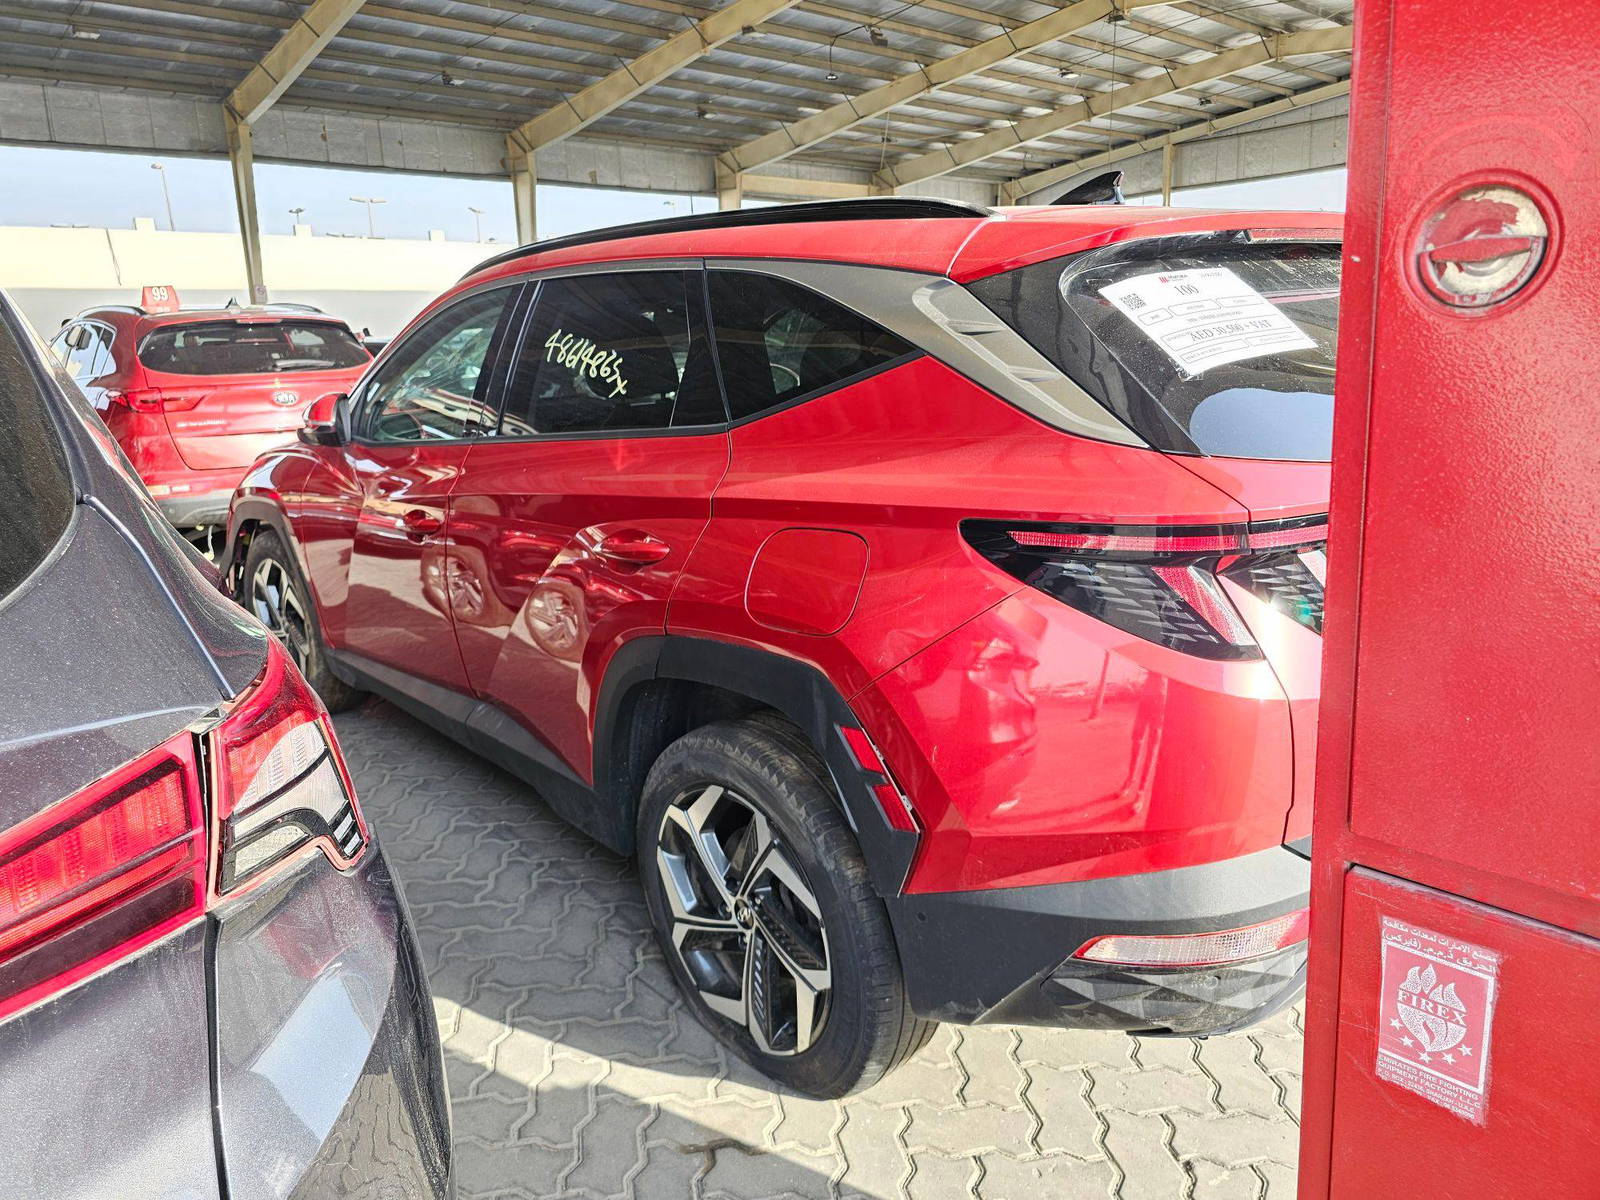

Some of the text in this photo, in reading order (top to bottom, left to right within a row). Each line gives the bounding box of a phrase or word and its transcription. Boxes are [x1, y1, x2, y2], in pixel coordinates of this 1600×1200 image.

[152, 286, 169, 301] 99
[1190, 328, 1214, 342] AED
[1249, 319, 1272, 329] VAT
[1397, 988, 1467, 1027] FIREX
[1377, 1060, 1419, 1082] QUIPMENT
[1419, 1078, 1459, 1099] FACTORY
[1419, 1071, 1438, 1083] FIRE
[1438, 1079, 1480, 1100] FIGHTING
